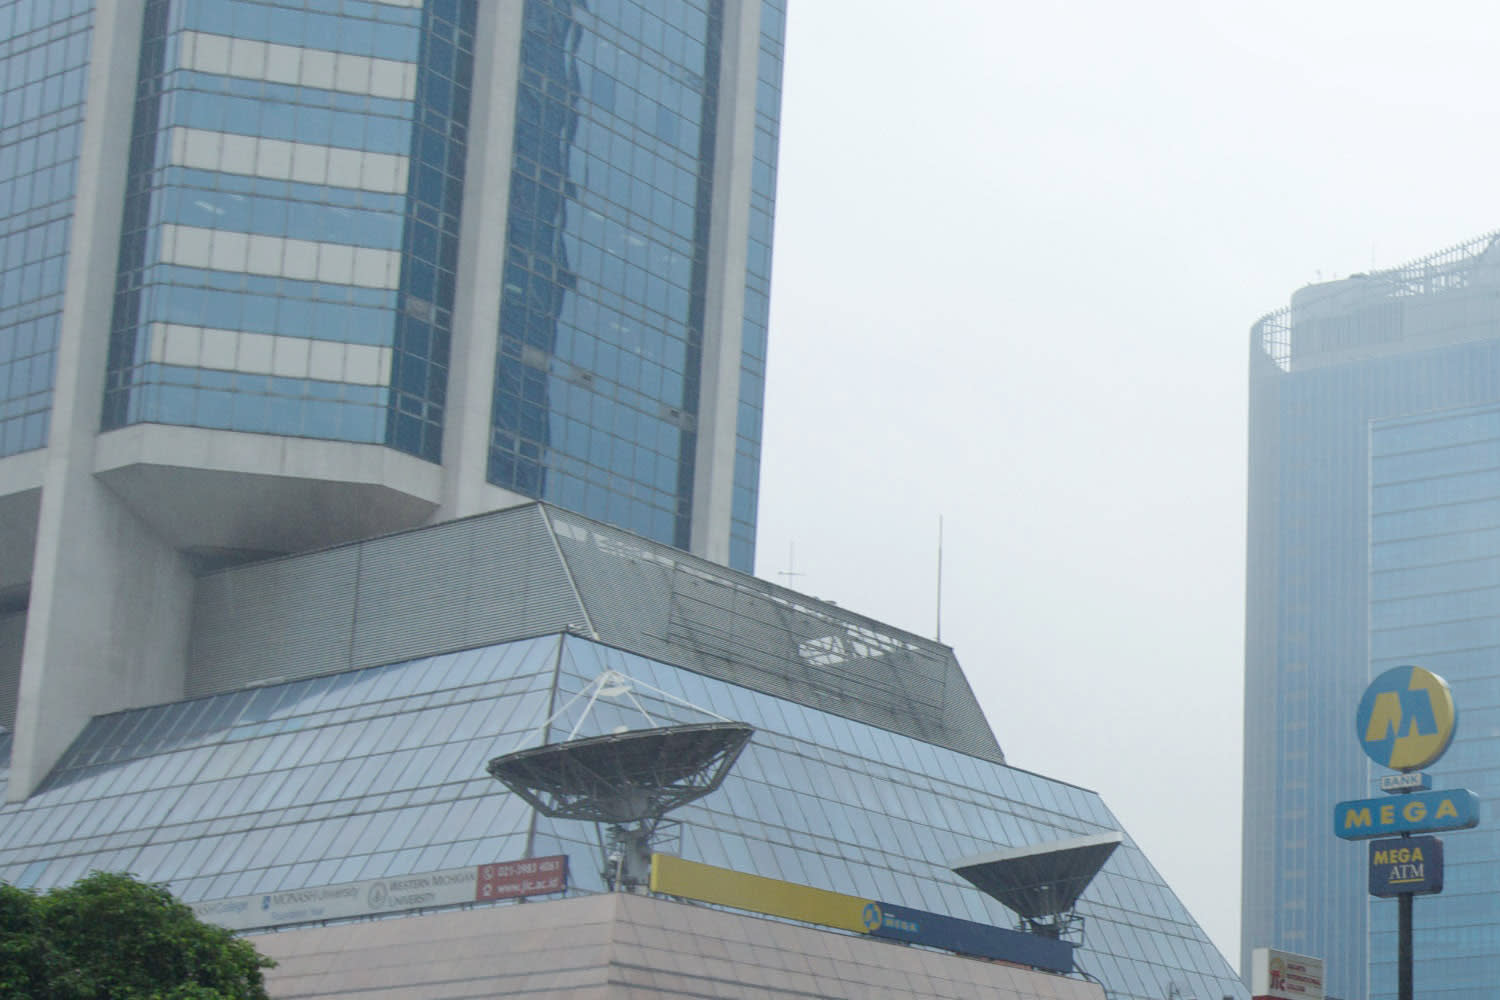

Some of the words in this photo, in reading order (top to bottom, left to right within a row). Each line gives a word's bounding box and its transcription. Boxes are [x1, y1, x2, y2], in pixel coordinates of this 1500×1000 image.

[1383, 774, 1420, 788] BANK
[1345, 799, 1458, 828] MEGA
[1374, 848, 1424, 865] MEGA
[1389, 864, 1425, 879] ATM
